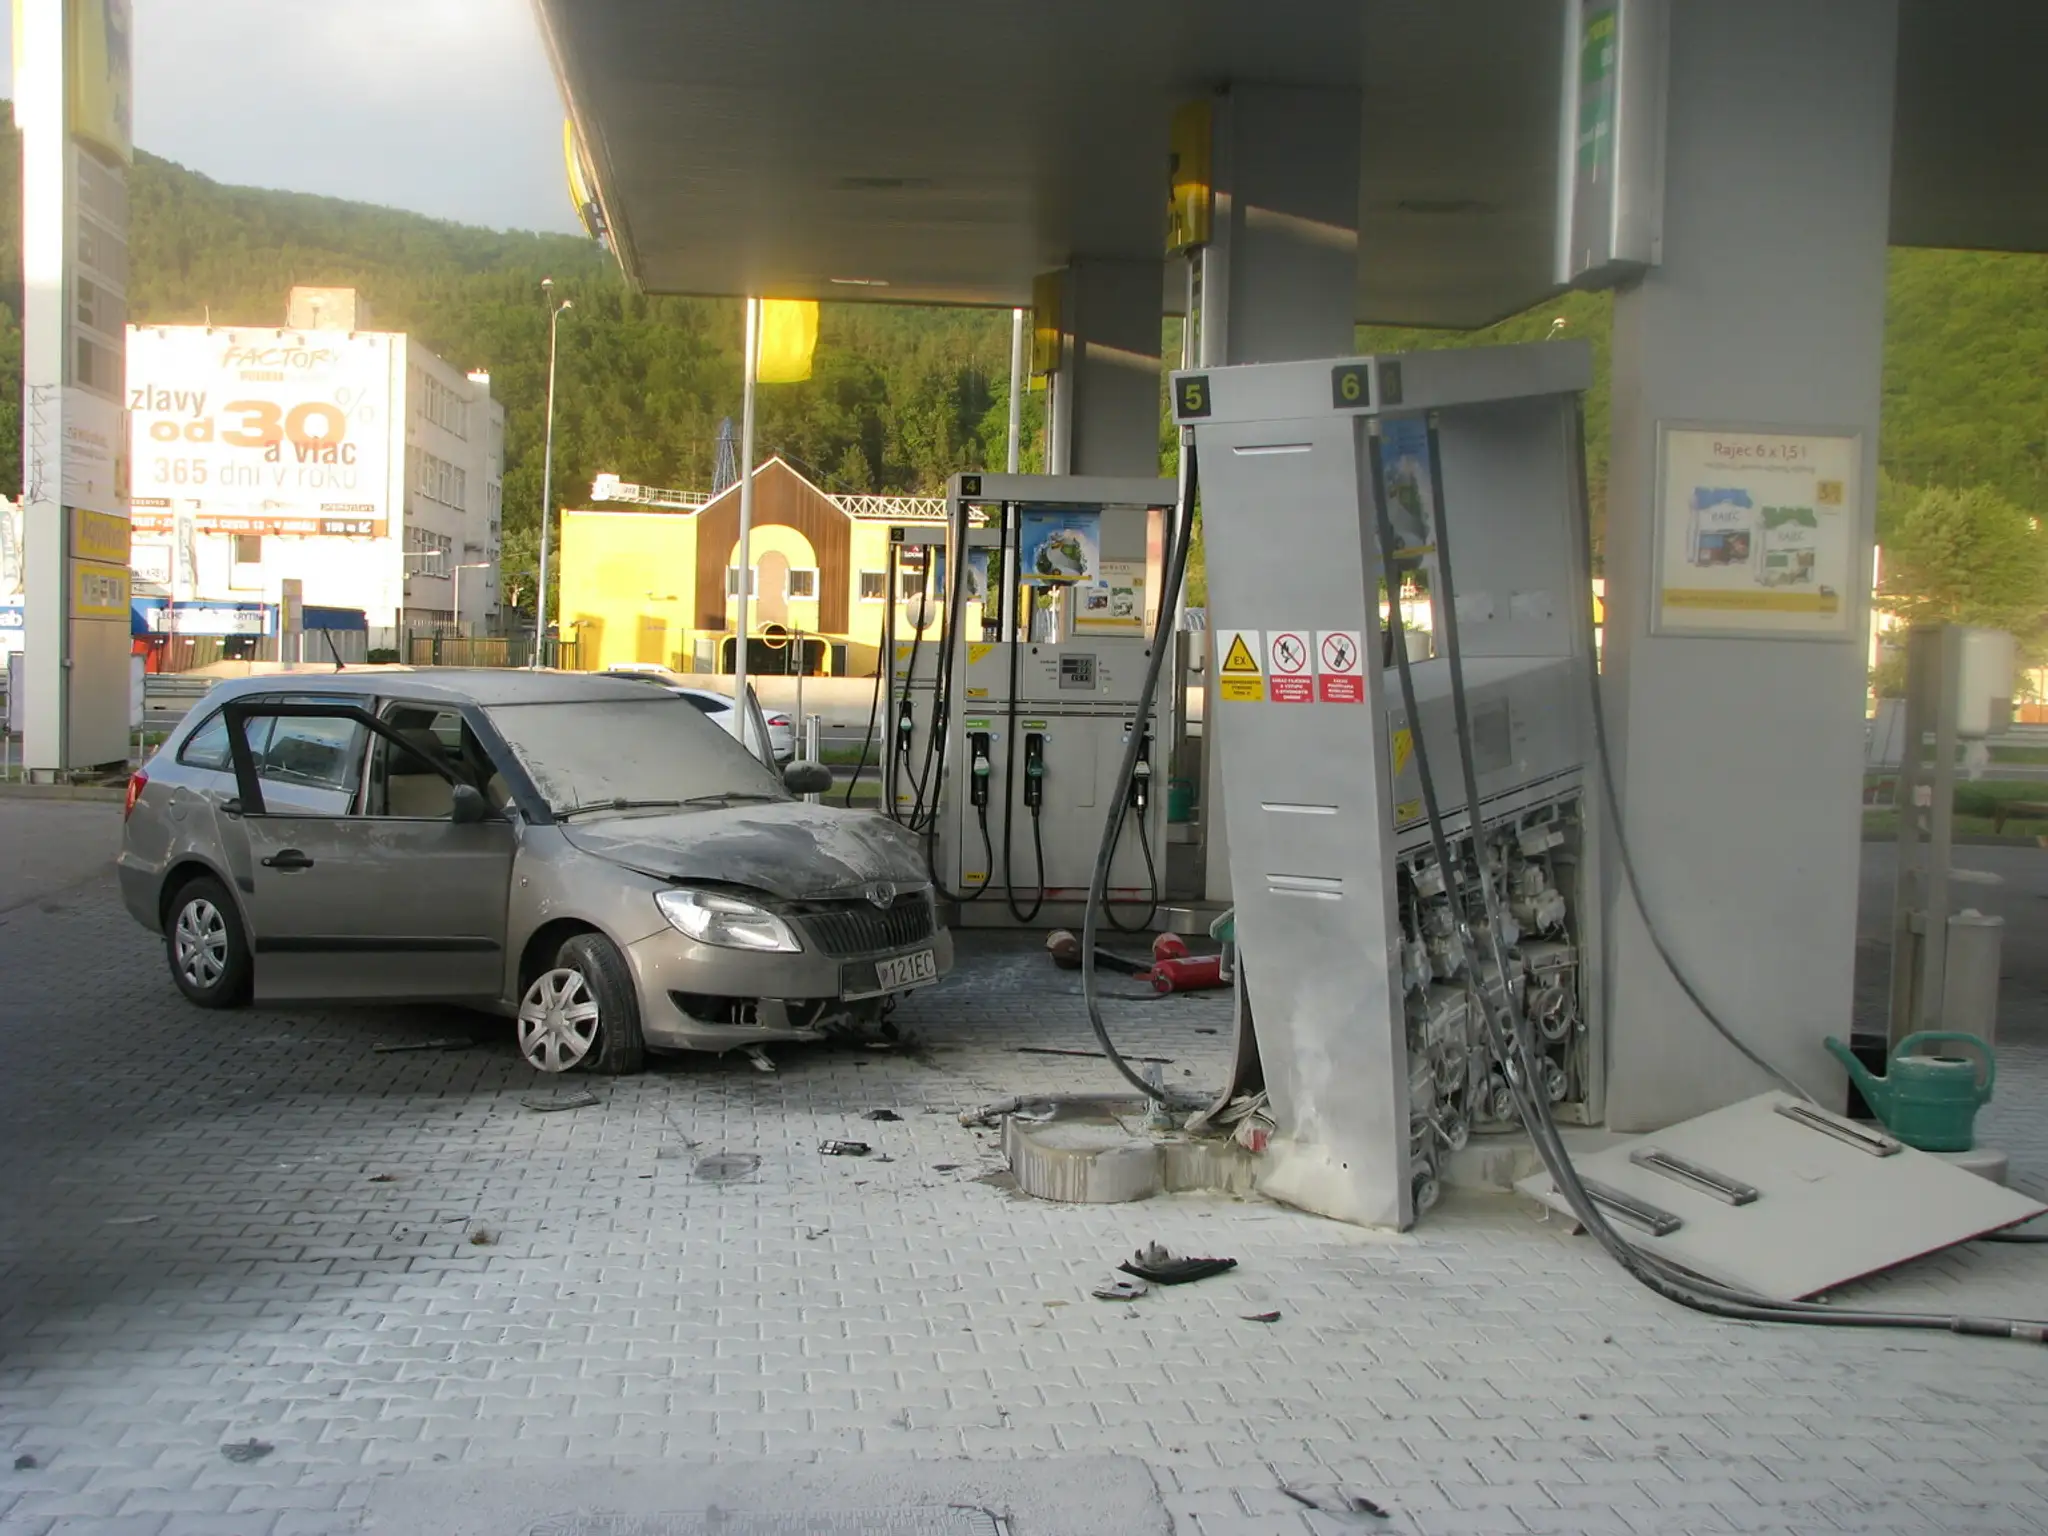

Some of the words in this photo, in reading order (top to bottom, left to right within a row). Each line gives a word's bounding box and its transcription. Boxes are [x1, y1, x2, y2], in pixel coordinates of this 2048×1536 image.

[1185, 383, 1203, 411] 5
[1341, 373, 1360, 400] 6
[149, 416, 215, 443] od
[264, 439, 282, 463] a
[293, 437, 357, 465] viac
[1713, 442, 1751, 459] Rajec
[1756, 446, 1765, 458] 6
[1769, 447, 1777, 457] x
[1780, 445, 1798, 461] 1,5
[154, 457, 208, 486] 365
[297, 463, 357, 491] roku
[966, 479, 976, 493] 4
[1233, 655, 1247, 666] EX
